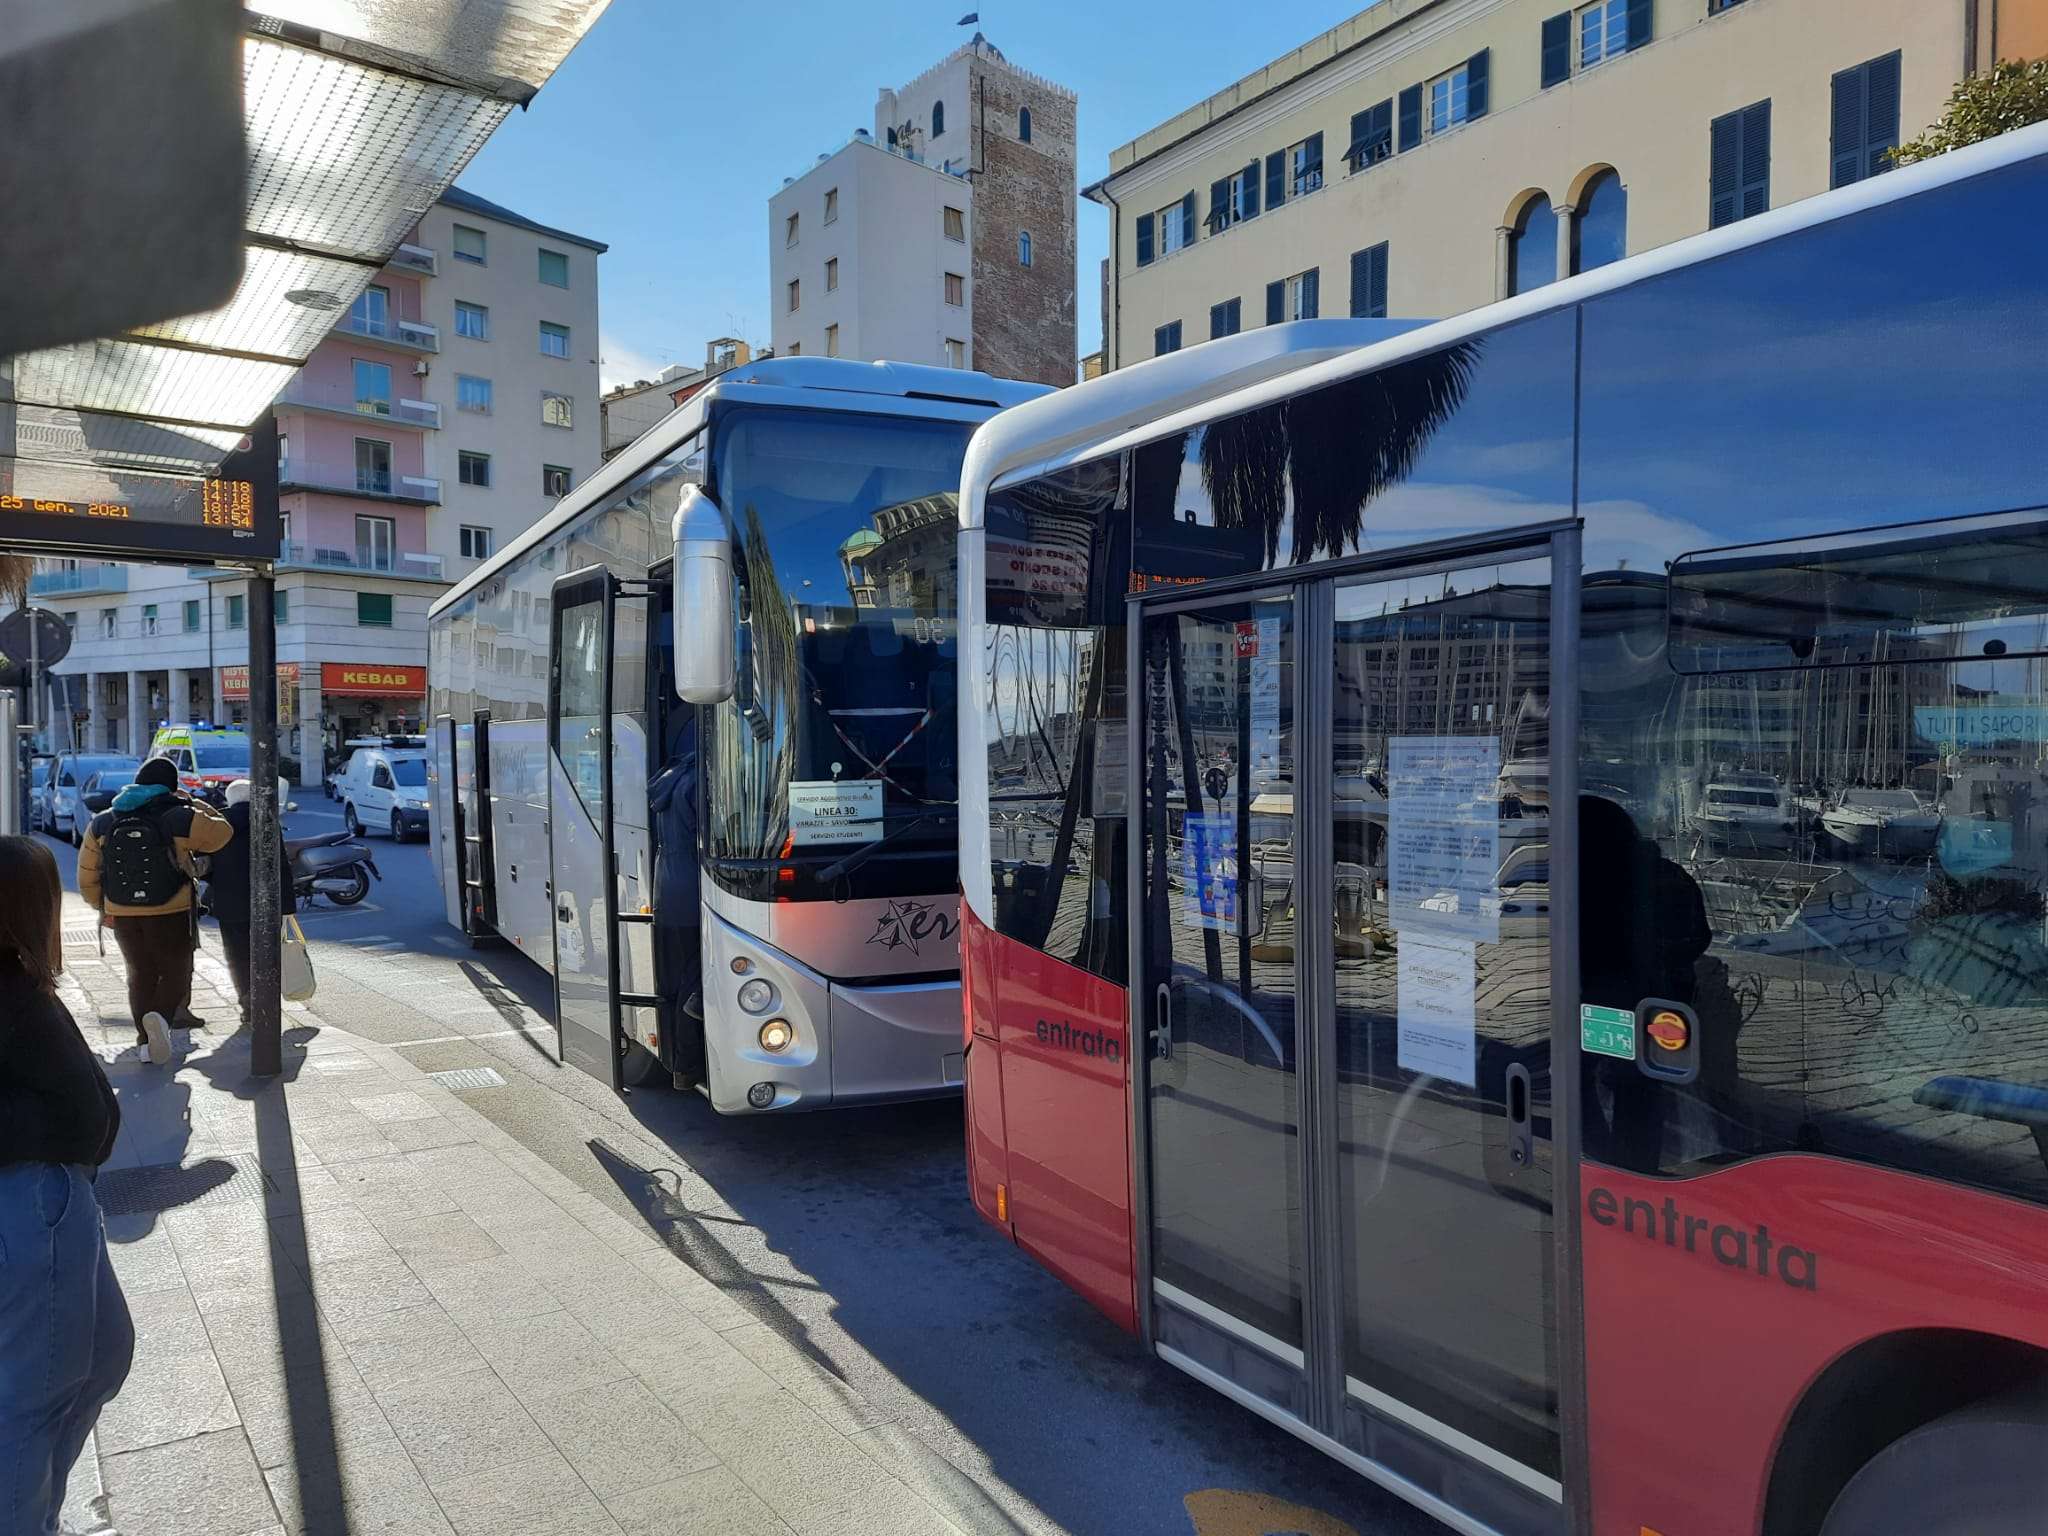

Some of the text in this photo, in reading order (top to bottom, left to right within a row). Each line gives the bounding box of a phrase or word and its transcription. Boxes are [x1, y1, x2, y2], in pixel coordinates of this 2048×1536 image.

[202, 479, 250, 493] 14:18
[0, 495, 129, 518] 25 Gen. 2021
[202, 513, 250, 527] 13:54
[224, 679, 250, 689] KEBA
[343, 672, 408, 685] KEBAB
[814, 806, 859, 816] LINEA 30:
[1036, 1018, 1120, 1064] entrata
[1587, 1187, 1818, 1292] entrata
